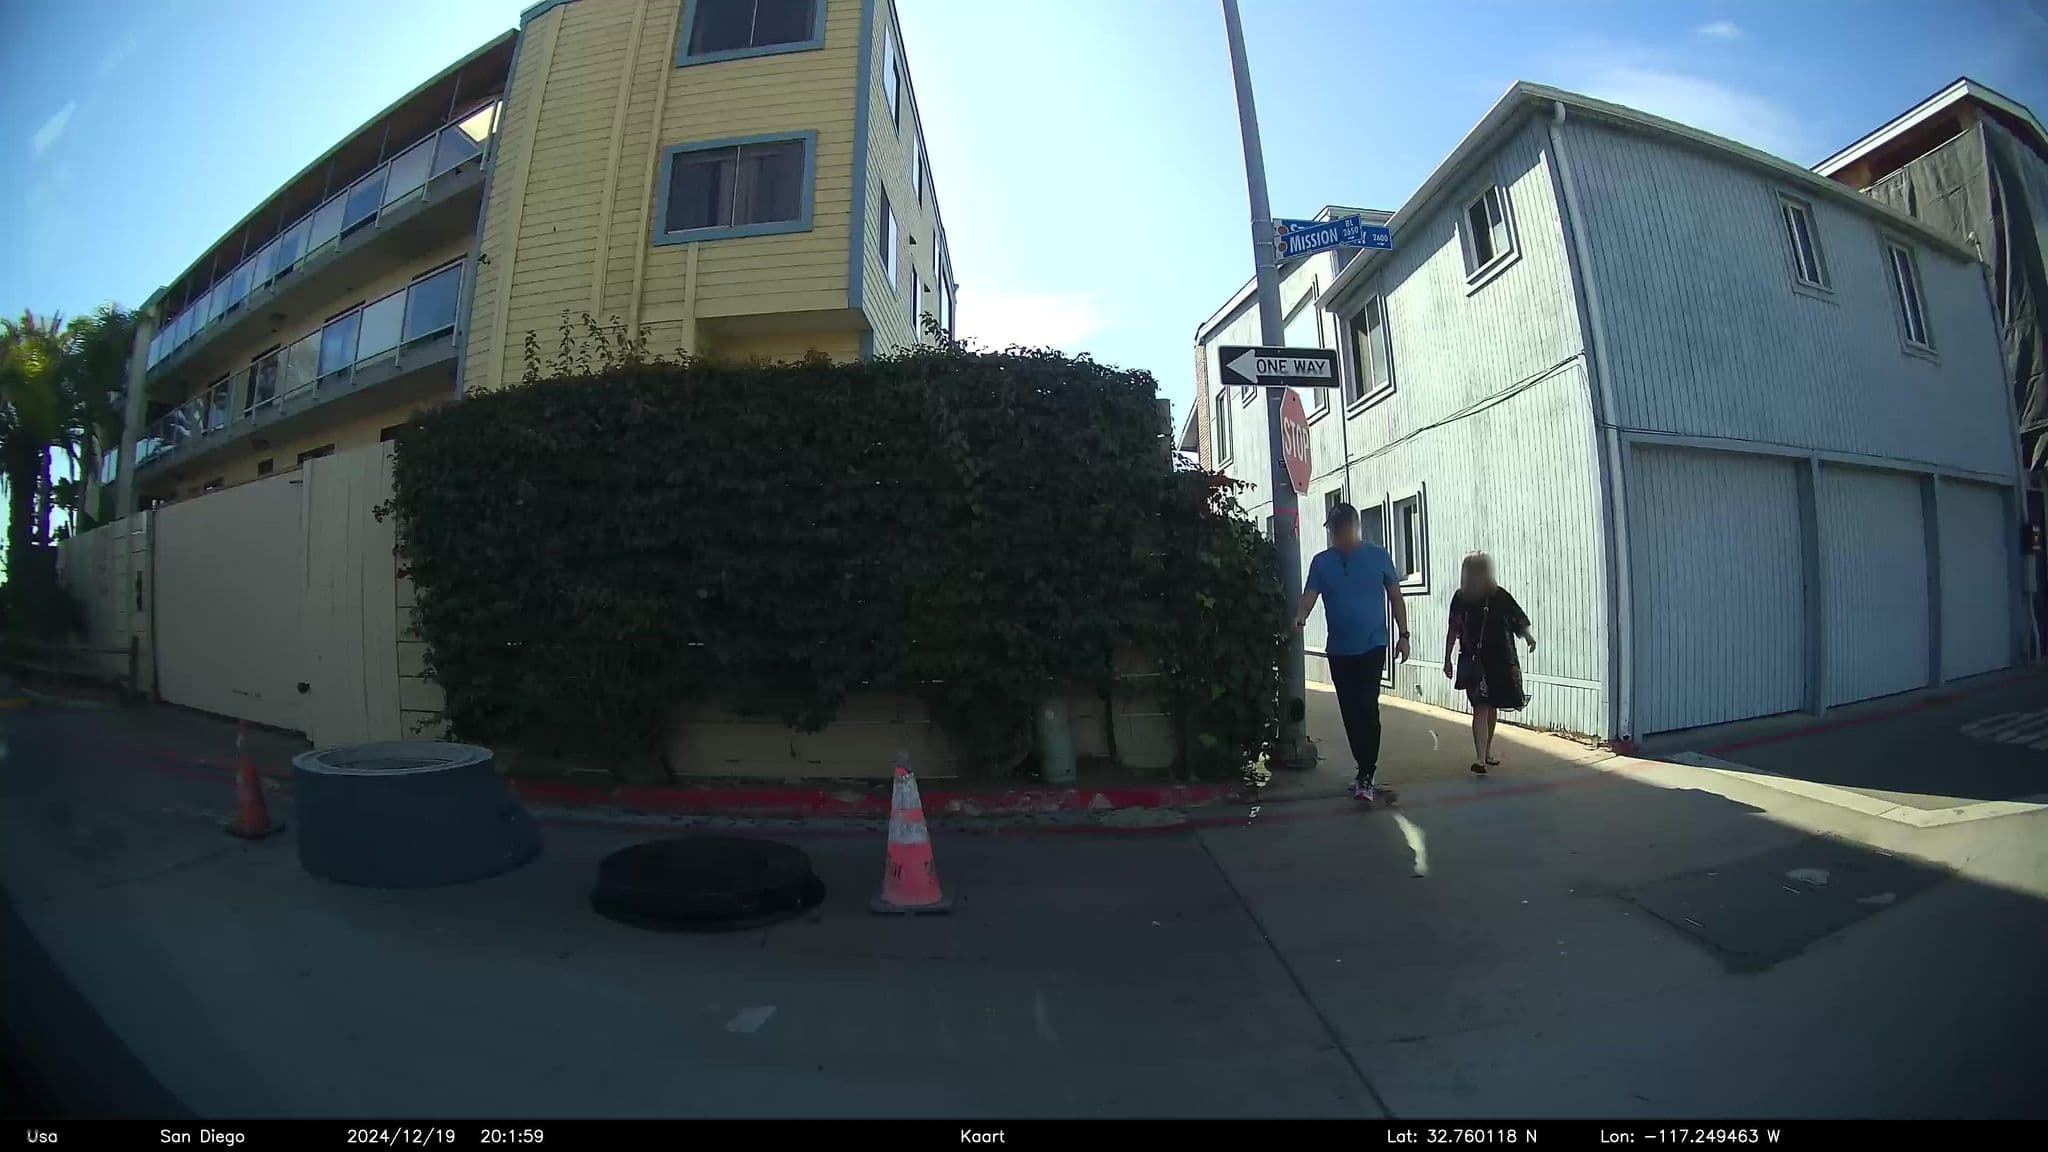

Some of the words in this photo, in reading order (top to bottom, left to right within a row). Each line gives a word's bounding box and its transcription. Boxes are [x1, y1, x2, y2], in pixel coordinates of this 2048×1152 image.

[1290, 227, 1339, 253] MISSION
[1343, 226, 1359, 236] 2650
[1256, 359, 1287, 374] ONE
[1294, 360, 1326, 375] WAY
[1284, 416, 1310, 463] STOP
